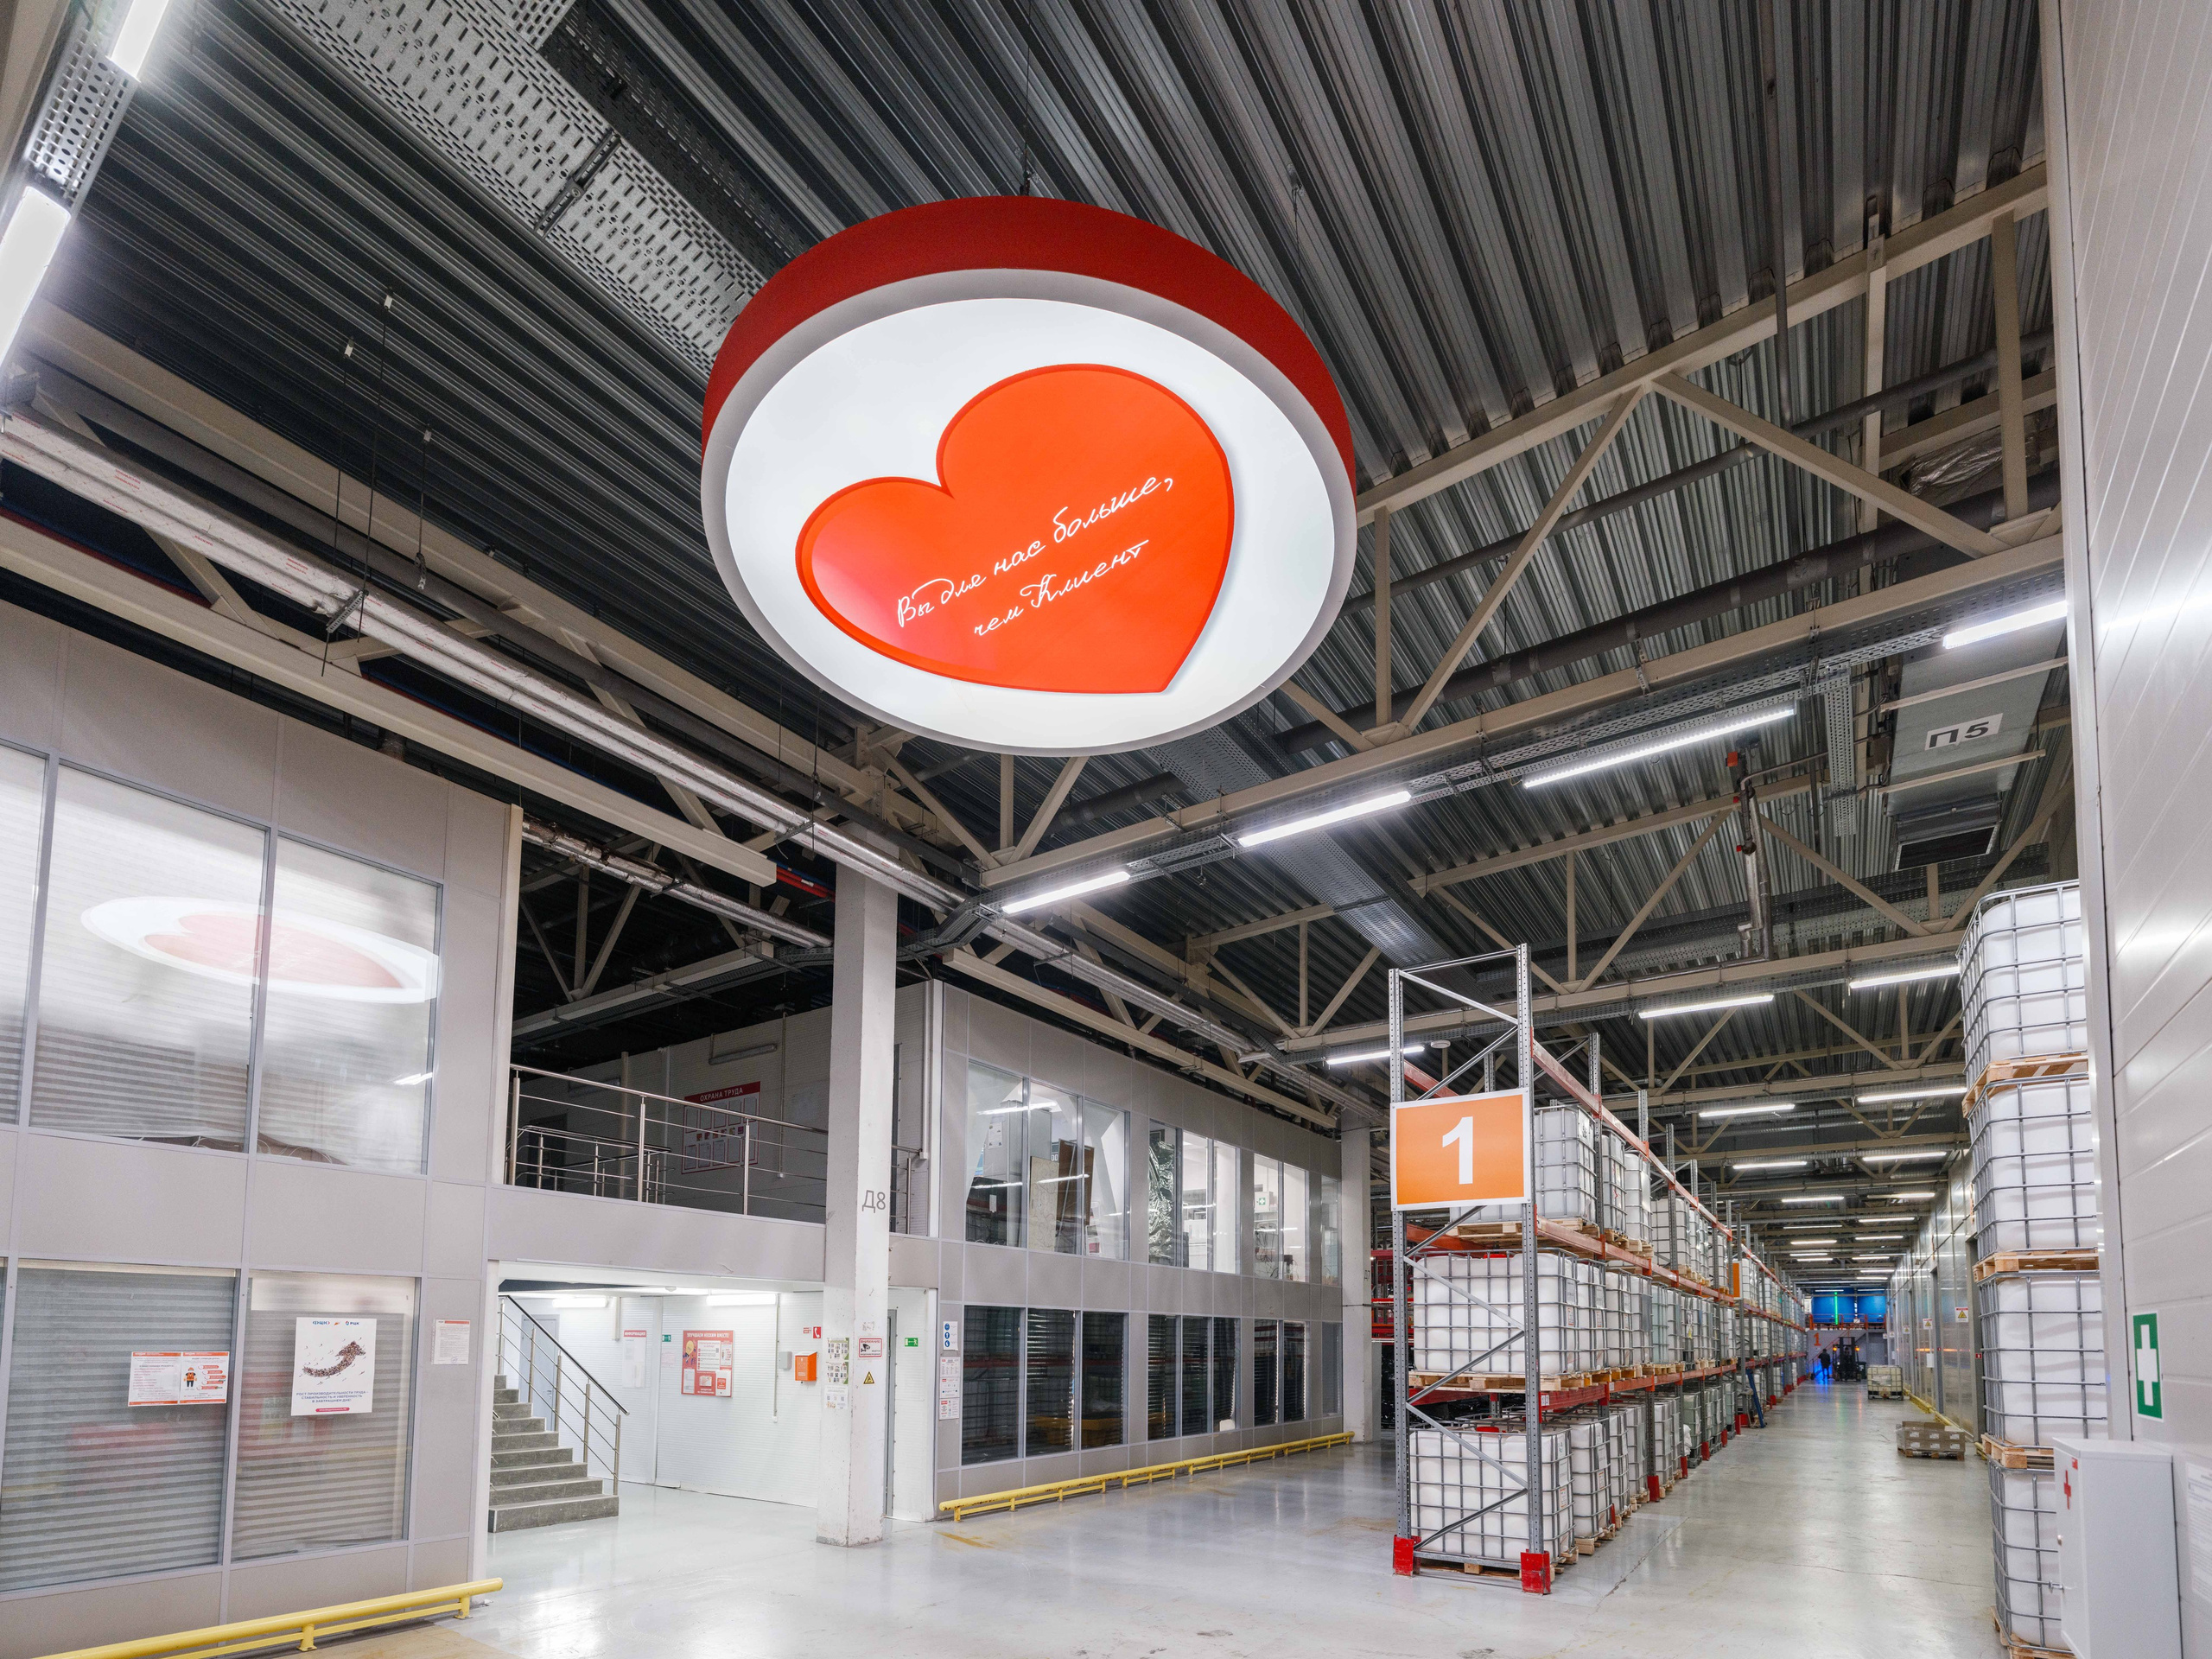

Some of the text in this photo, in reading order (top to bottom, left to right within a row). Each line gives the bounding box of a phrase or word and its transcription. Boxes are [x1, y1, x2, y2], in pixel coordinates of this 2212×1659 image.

[896, 476, 1173, 627] Вы для нас больше,
[974, 539, 1149, 636] чем Клиент
[699, 1087, 743, 1102] ОХРАНА ТРУДА
[1442, 1116, 1473, 1185] 1
[861, 1189, 887, 1213] Д8
[1814, 1332, 1821, 1346] 1
